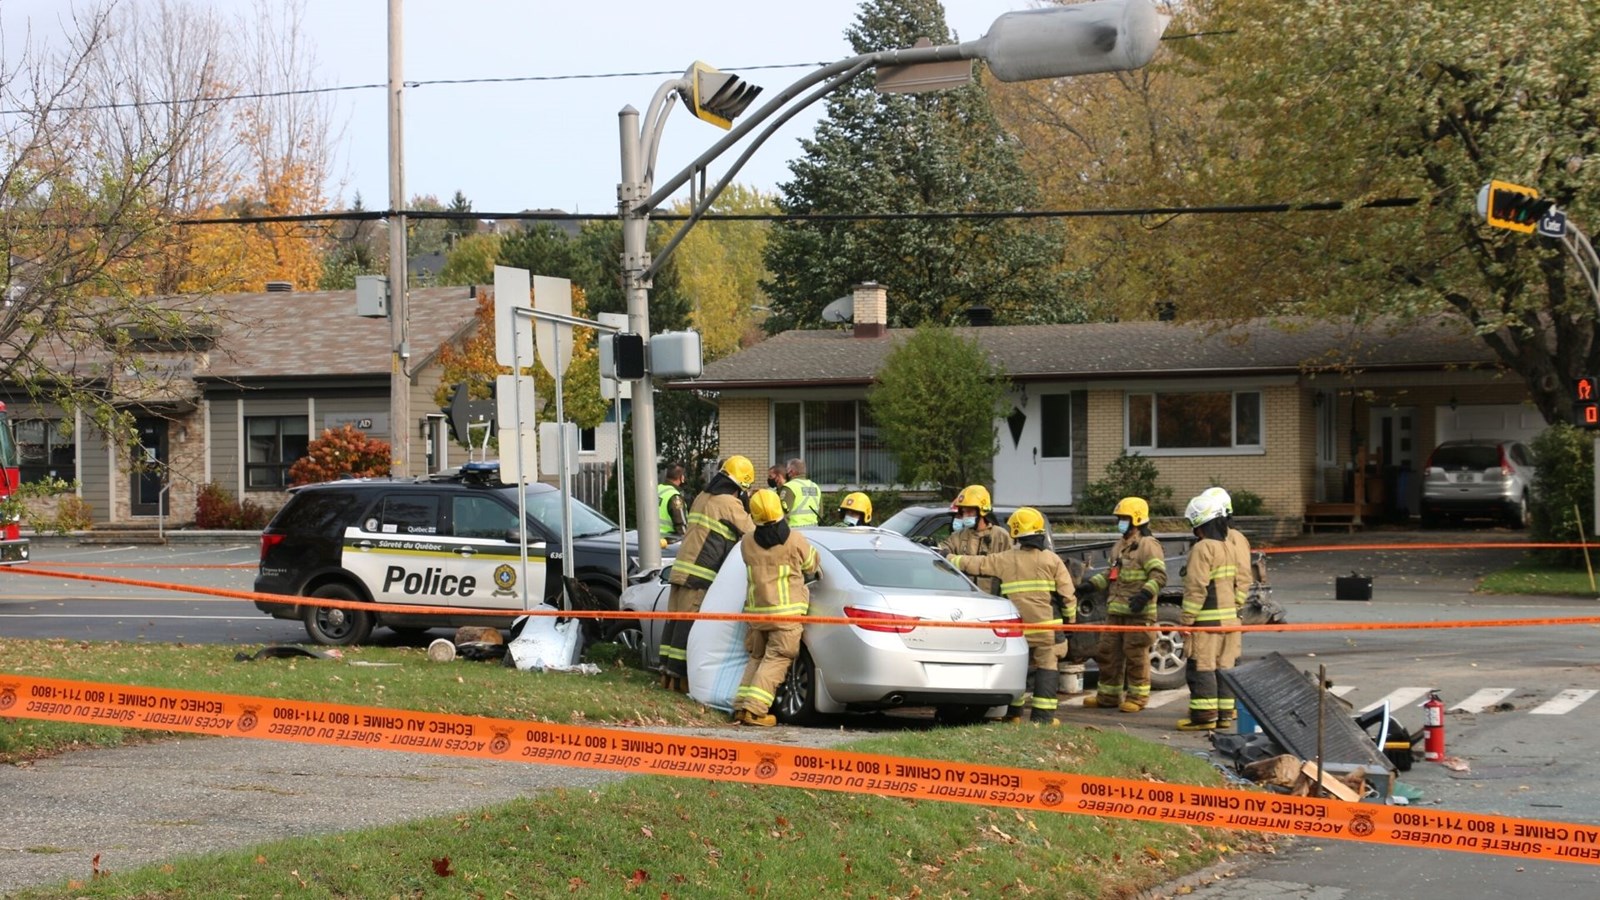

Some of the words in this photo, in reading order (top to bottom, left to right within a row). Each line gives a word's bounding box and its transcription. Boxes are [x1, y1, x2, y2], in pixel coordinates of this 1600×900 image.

[1585, 406, 1598, 423] 0
[407, 525, 429, 533] Québec
[379, 540, 402, 548] Sûreté
[414, 542, 442, 550] Québec
[382, 565, 476, 597] Police
[31, 685, 81, 700] 711-1800
[85, 690, 105, 703] 800
[109, 693, 114, 704] 1
[118, 693, 156, 708] CRIME
[160, 697, 177, 709] AU
[26, 701, 72, 715] QUÉBEC
[73, 706, 90, 716] DU
[180, 699, 222, 716] ÉCHEC
[91, 707, 135, 722] SÛRETÉ
[142, 713, 193, 725] INTERDIT
[273, 707, 325, 723] 711-1800
[328, 712, 350, 725] 800
[354, 715, 359, 725] 1
[195, 717, 234, 729] ACCÈS
[363, 715, 404, 730] CRIME
[407, 719, 425, 731] AU
[269, 723, 315, 736] QUÉBEC
[317, 728, 334, 738] DU
[429, 721, 473, 738] ÉCHEC
[336, 730, 382, 744] SÛRETÉ
[390, 735, 443, 747] INTERDIT
[527, 730, 581, 746] 711-1800
[585, 736, 607, 749] 800
[445, 739, 485, 751] ACCÈS
[612, 738, 617, 750] 1
[621, 739, 664, 754] CRIME
[667, 743, 686, 756] AU
[522, 746, 571, 760] QUÉBEC
[573, 751, 591, 762] DU
[690, 745, 737, 764] ÉCHEC
[593, 753, 641, 768] SÛRETÉ
[650, 759, 706, 772] INTERDIT
[794, 755, 853, 772] 711-1800
[708, 764, 750, 776] ACCÈS
[856, 761, 880, 774] 800
[886, 764, 891, 775] 1
[896, 764, 941, 780] CRIME
[790, 772, 843, 785] QUÉBEC
[845, 777, 864, 787] DU
[945, 769, 965, 783] AU
[970, 771, 1020, 791] ÉCHEC
[867, 779, 918, 793] SÛRETÉ
[927, 785, 987, 799] INTERDIT
[1081, 782, 1144, 800] 711-1800
[990, 791, 1035, 803] ACCÈS
[1148, 789, 1174, 803] 800
[1180, 792, 1186, 804] 1
[1191, 793, 1240, 810] CRIME
[1078, 800, 1134, 813] QUÉBEC
[1137, 805, 1157, 816] DU
[1245, 799, 1266, 812] AU
[1271, 801, 1326, 820] ÉCHEC
[1160, 808, 1215, 822] SÛRETÉ
[1393, 813, 1463, 830] 711-1800
[1226, 815, 1290, 829] INTERDIT
[1294, 820, 1343, 833] ACCÈS
[1467, 820, 1495, 834] 800
[1502, 823, 1509, 835] 1
[1514, 824, 1569, 841] CRIME
[1391, 830, 1452, 844] QUÉBEC
[1456, 836, 1478, 847] DU
[1574, 830, 1598, 844] AU
[1481, 838, 1542, 854] SÛRETÉ
[1555, 846, 1600, 859] ERDIT
